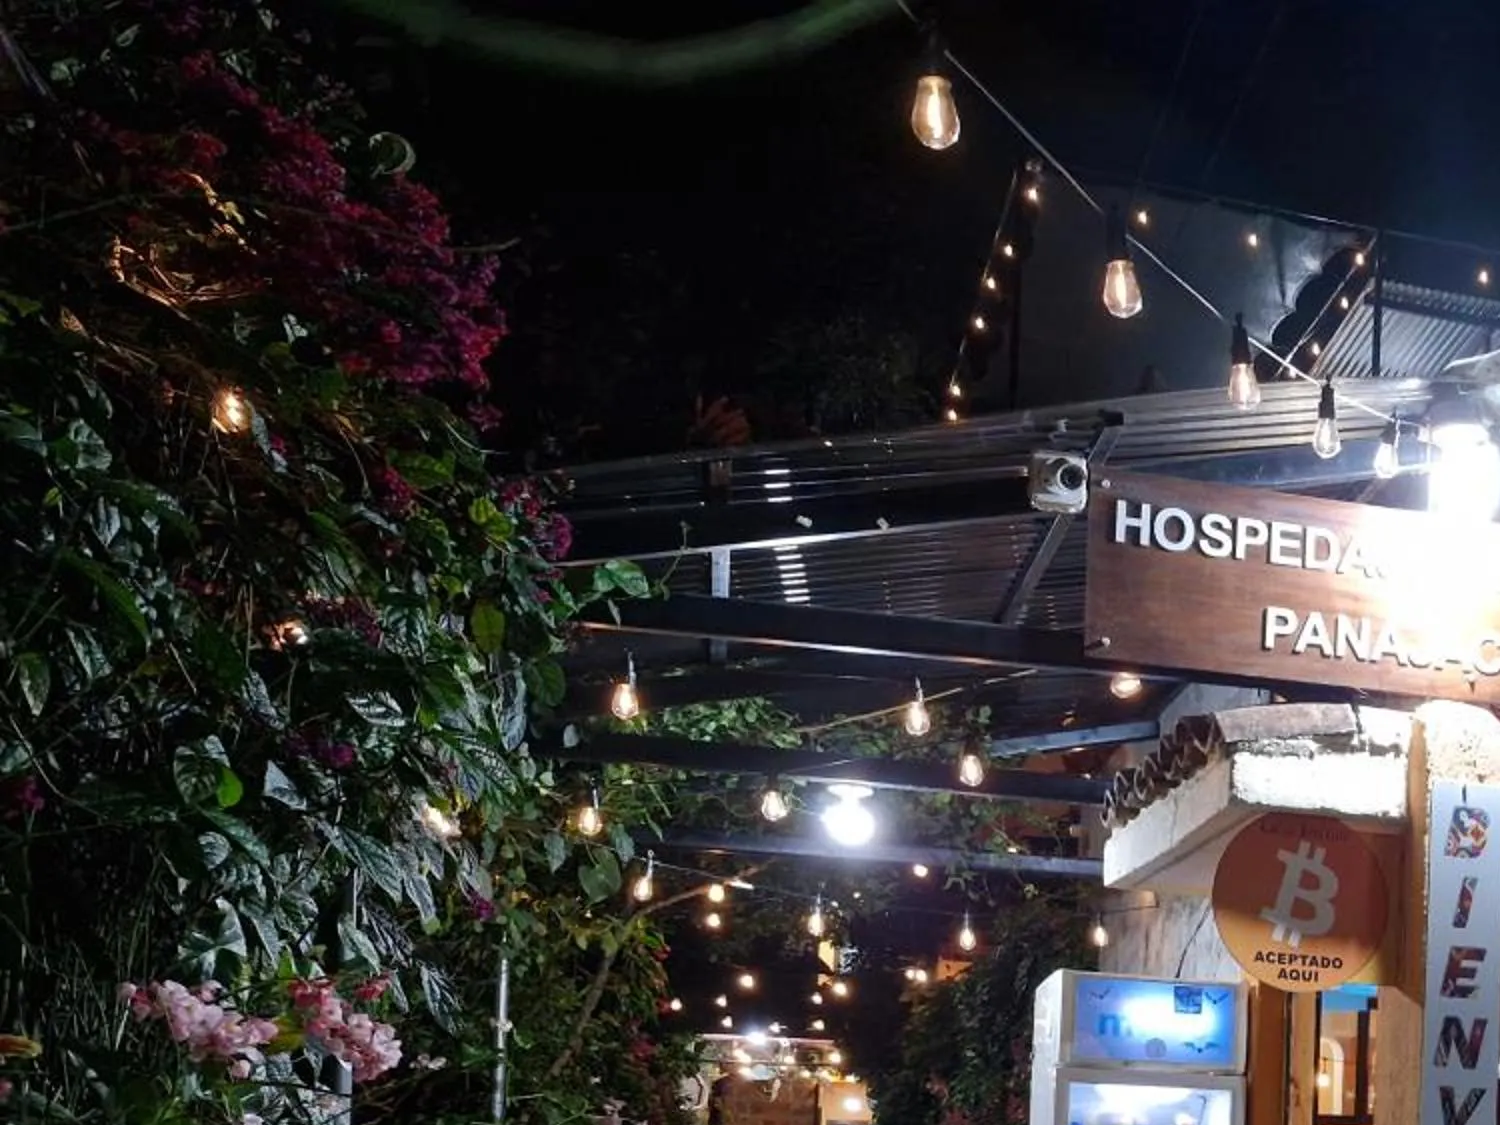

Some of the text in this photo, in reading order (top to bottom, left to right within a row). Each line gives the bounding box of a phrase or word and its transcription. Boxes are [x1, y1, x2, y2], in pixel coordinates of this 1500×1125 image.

[1113, 498, 1436, 586] HOSPEDA
[1254, 951, 1343, 969] ACEPTADO
[1278, 969, 1319, 983] AQUI
